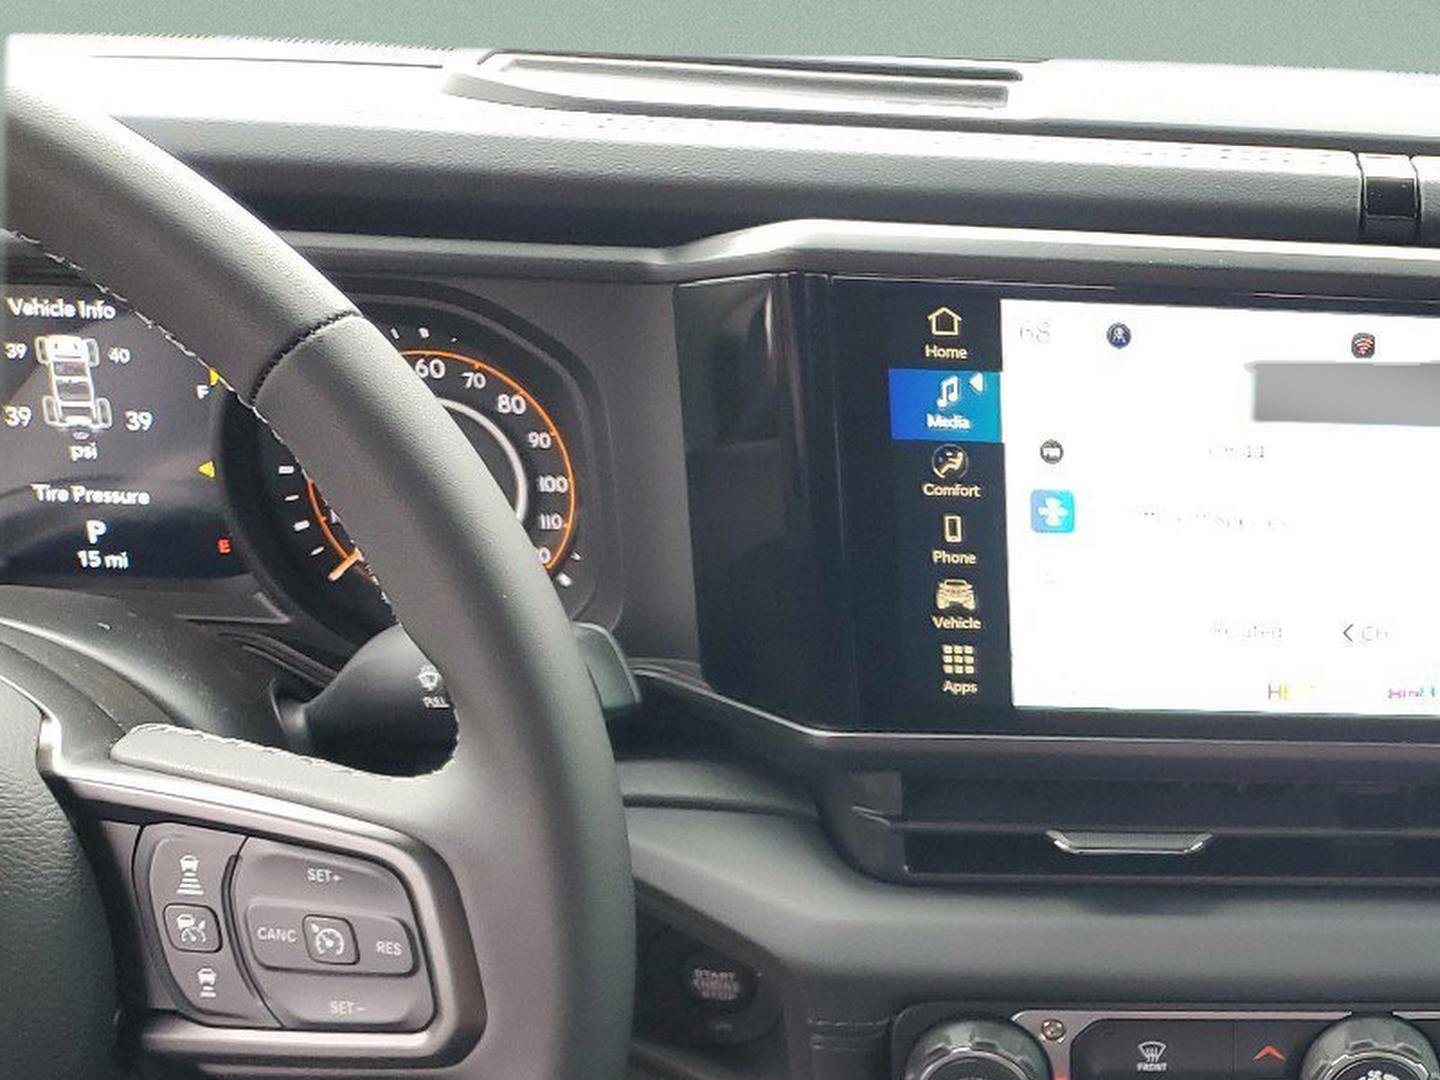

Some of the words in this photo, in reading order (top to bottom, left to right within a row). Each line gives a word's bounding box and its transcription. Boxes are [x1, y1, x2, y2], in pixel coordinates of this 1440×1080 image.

[7, 297, 76, 318] Vehicle
[78, 299, 116, 320] Info
[4, 342, 28, 360] 39
[107, 346, 131, 364] 40
[925, 344, 968, 360] Home
[415, 358, 446, 379] 60
[461, 372, 487, 390] 70
[195, 384, 210, 400] F
[497, 394, 527, 415] 80
[4, 405, 32, 428] 39
[125, 410, 153, 432] 39
[927, 414, 970, 431] Media
[528, 431, 552, 449] 90
[69, 441, 98, 462] psi
[536, 475, 568, 493] 100
[923, 482, 980, 499] Comfort
[31, 483, 69, 502] Tire
[70, 485, 150, 505] Pressure
[539, 513, 563, 529] 110
[86, 519, 107, 544] P
[217, 537, 231, 555] E
[76, 550, 102, 568] 15
[105, 551, 129, 570] mi
[933, 550, 976, 567] Phone
[932, 615, 981, 630] Vehicle
[942, 680, 978, 696] Apps
[257, 926, 297, 944] CANC
[375, 941, 402, 956] RES
[1137, 1061, 1168, 1072] FRONT
